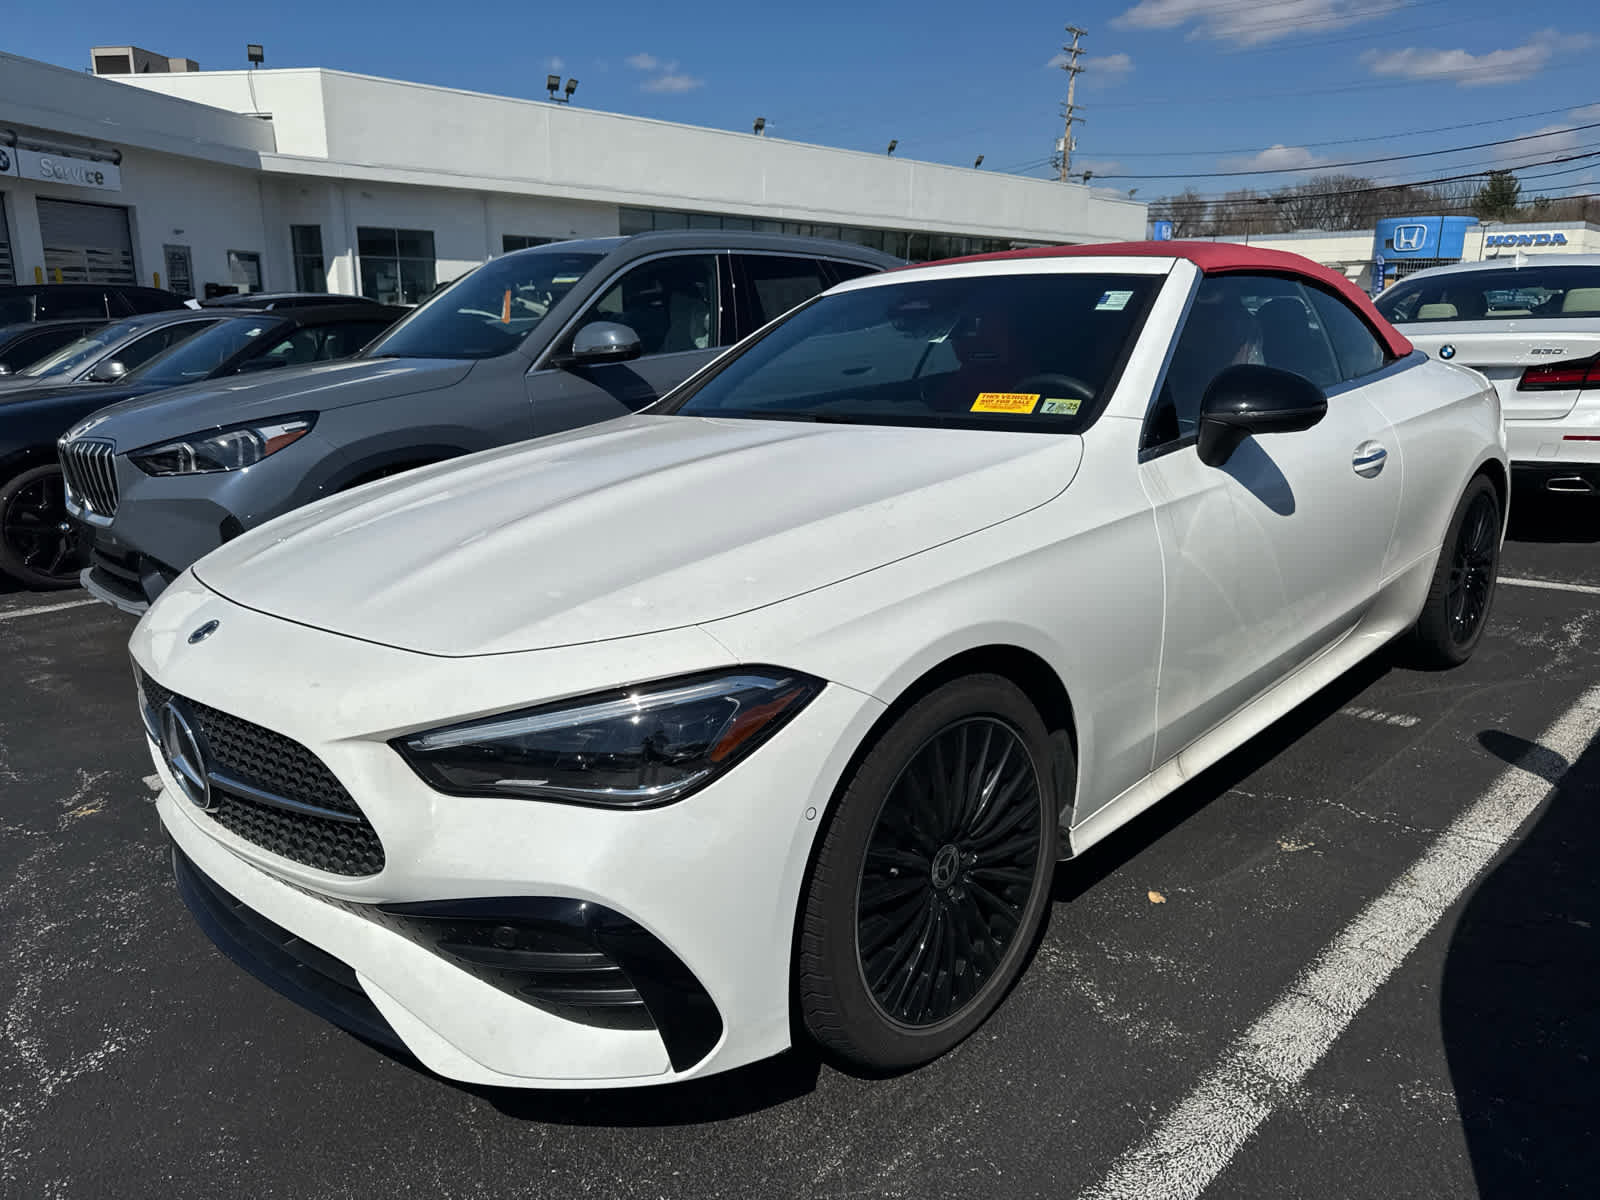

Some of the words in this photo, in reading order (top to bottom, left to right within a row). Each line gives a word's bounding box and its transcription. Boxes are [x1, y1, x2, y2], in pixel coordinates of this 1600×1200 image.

[40, 158, 104, 185] Service
[1486, 232, 1569, 248] HONDA
[1046, 402, 1057, 411] 7
